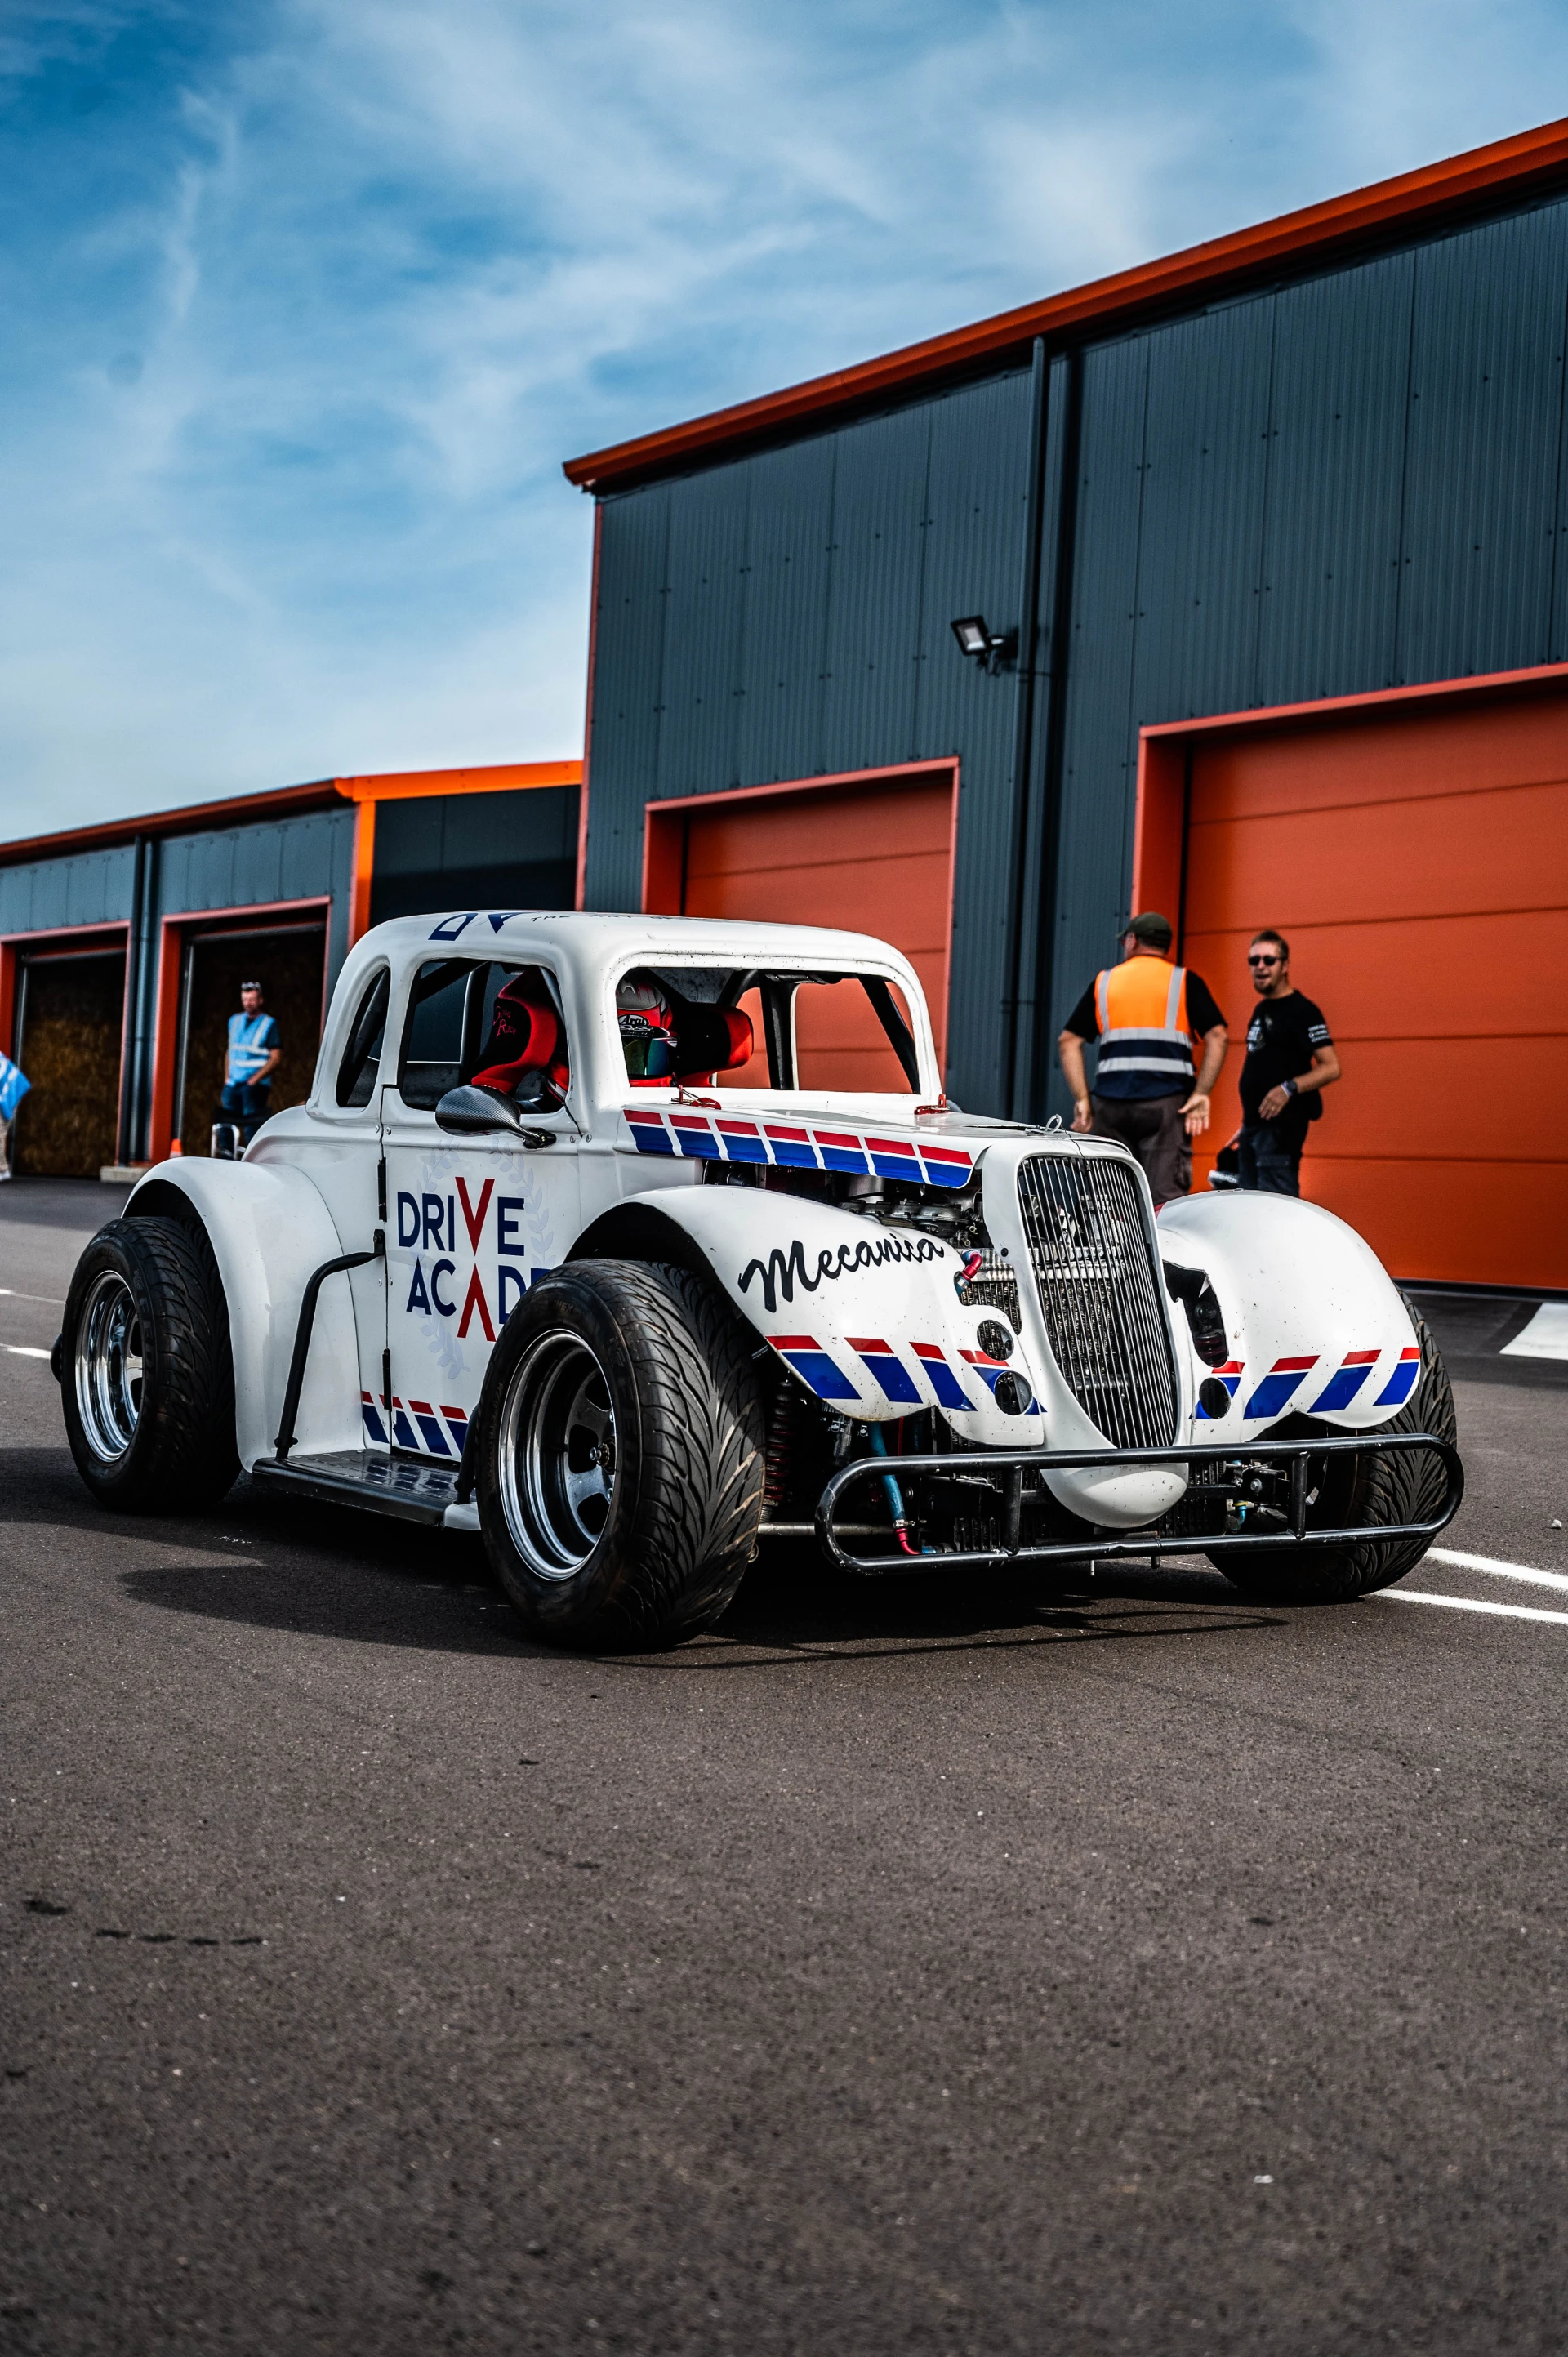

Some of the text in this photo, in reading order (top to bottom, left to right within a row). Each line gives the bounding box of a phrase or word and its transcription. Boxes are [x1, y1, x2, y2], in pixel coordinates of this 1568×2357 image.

[397, 1176, 525, 1257] DRIVE
[406, 1256, 551, 1342] ACAD
[737, 1233, 945, 1314] Mecanica
